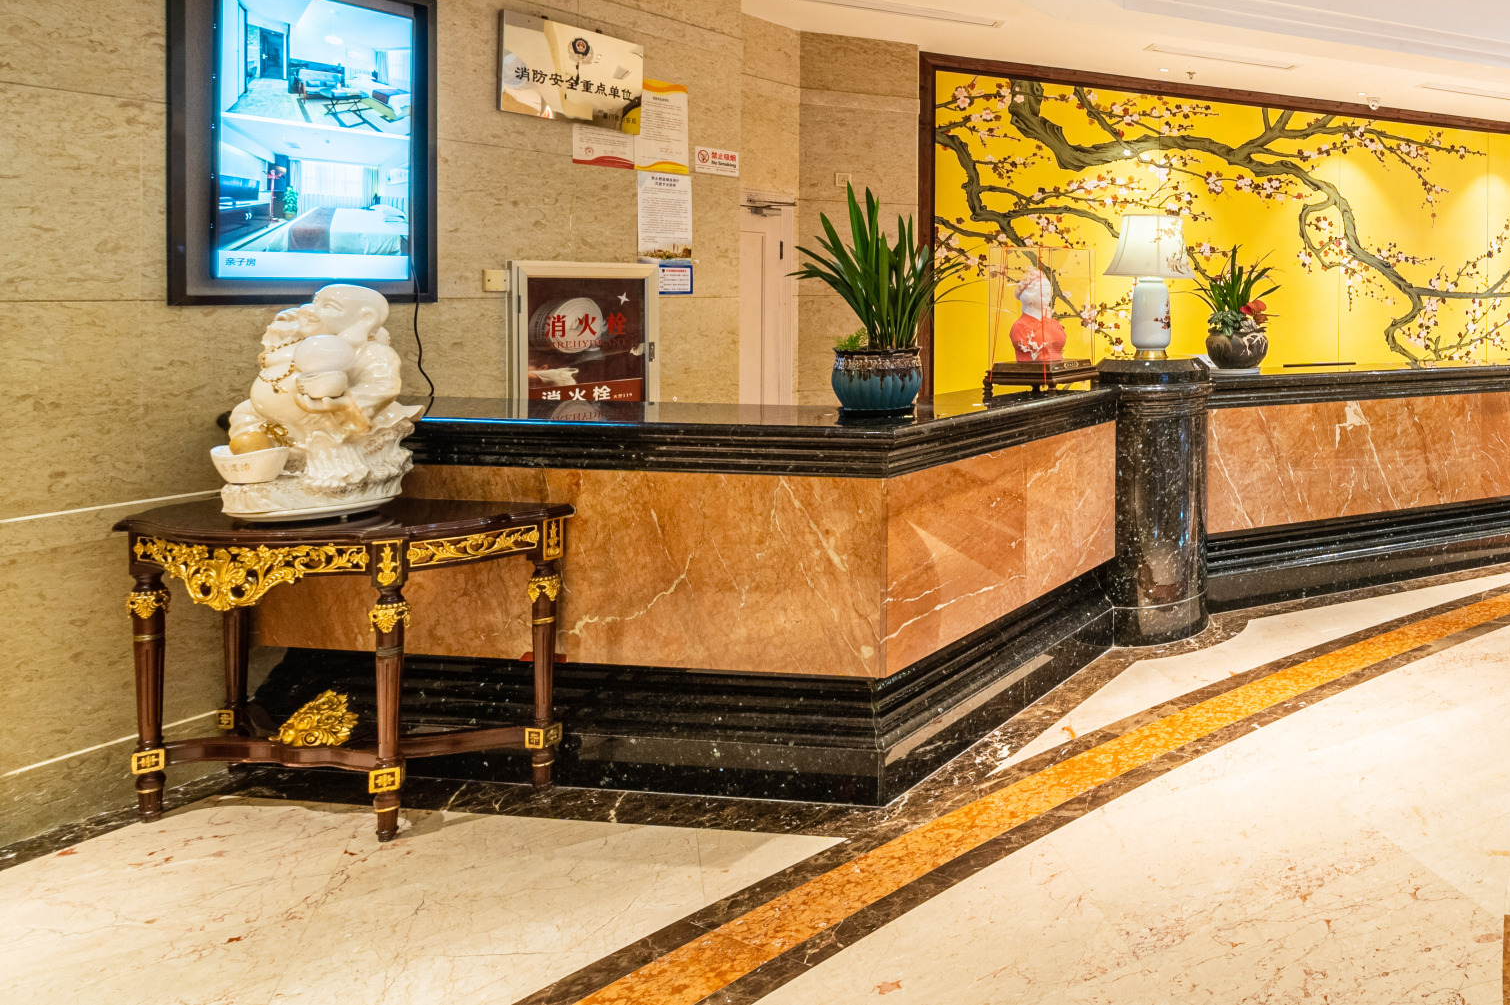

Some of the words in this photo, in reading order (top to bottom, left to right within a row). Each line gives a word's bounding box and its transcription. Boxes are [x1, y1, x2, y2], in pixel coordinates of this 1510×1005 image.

[514, 67, 634, 102] 消防安全重点单位
[711, 151, 736, 162] 禁止吸烟
[718, 160, 737, 169] Smoking
[225, 257, 256, 266] 亲子房
[545, 313, 626, 338] 消火栓
[547, 338, 628, 349] IREHYDRANT
[541, 385, 611, 401] 消火栓
